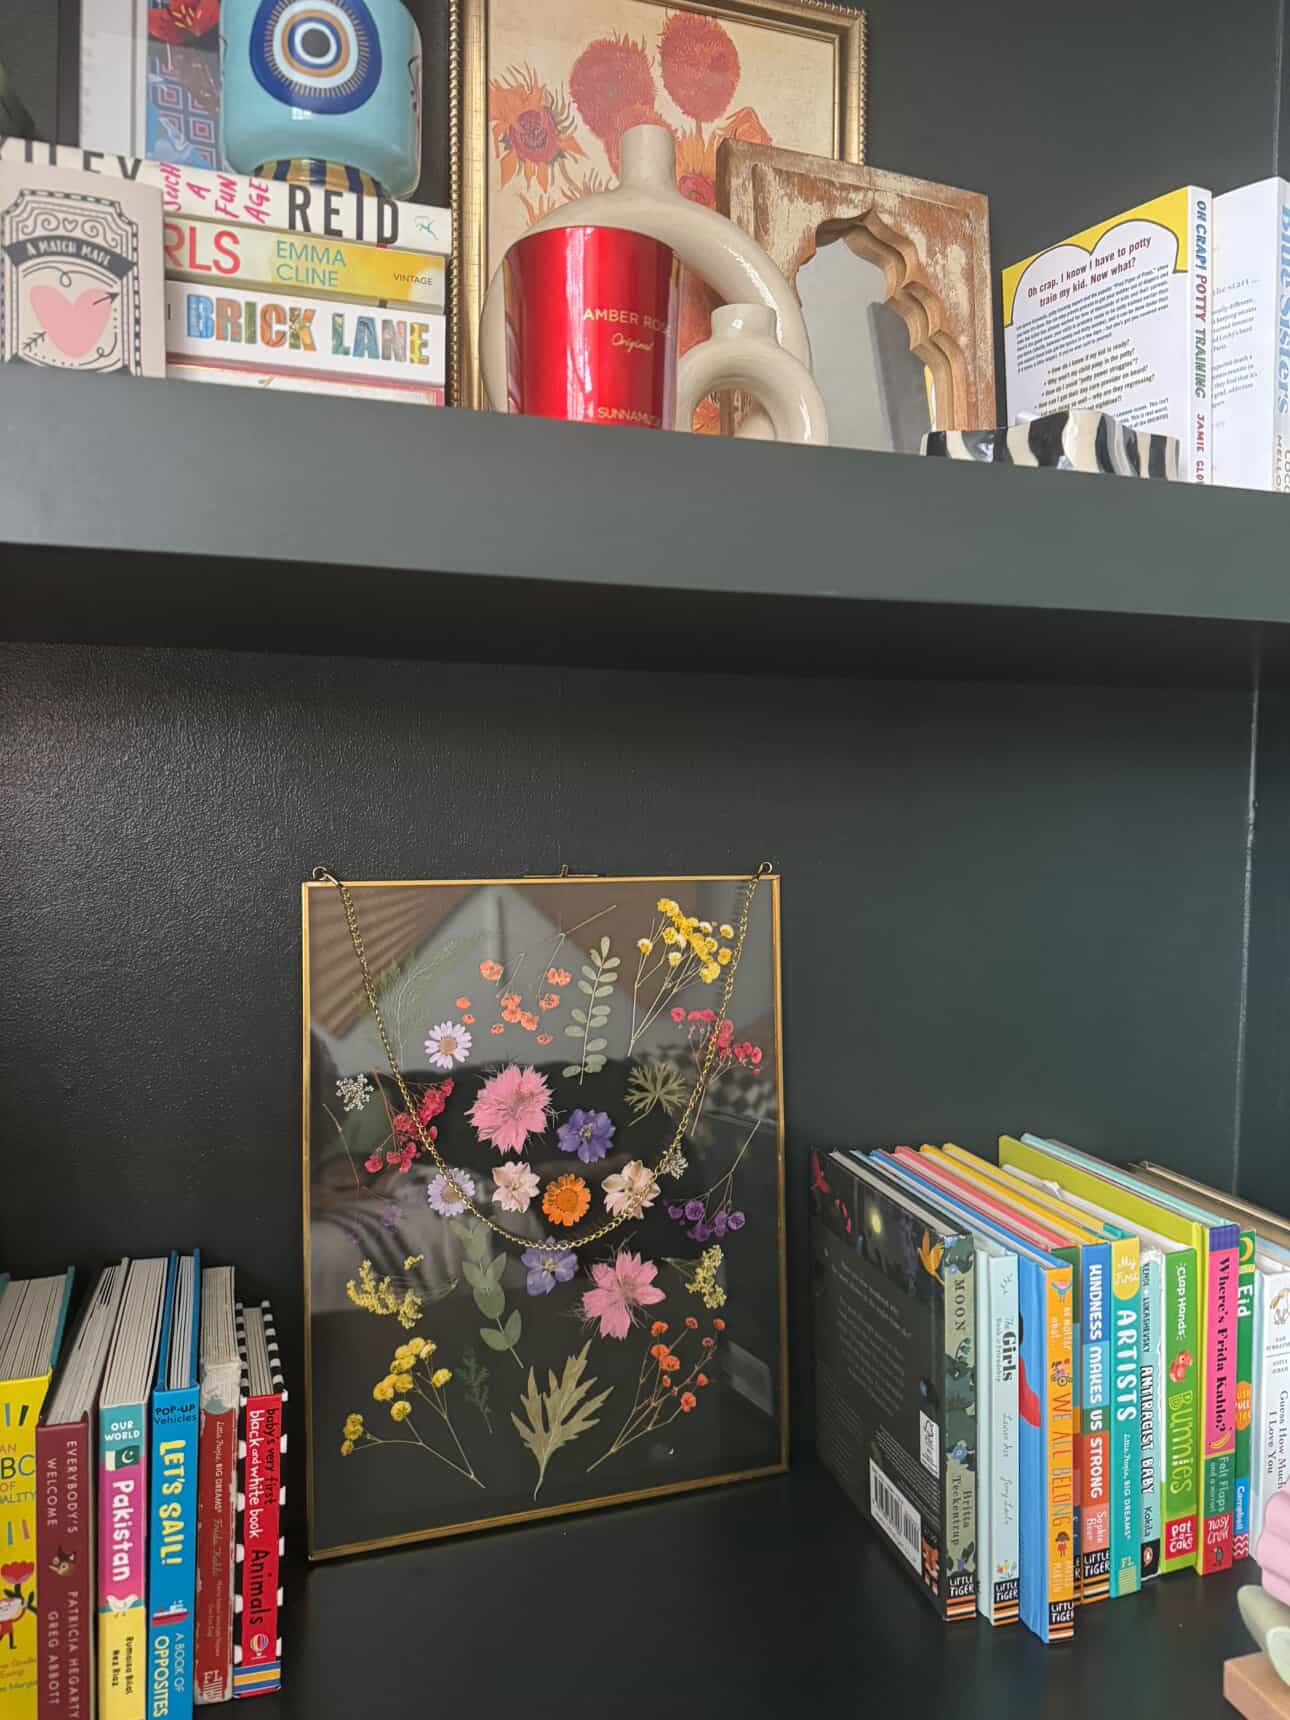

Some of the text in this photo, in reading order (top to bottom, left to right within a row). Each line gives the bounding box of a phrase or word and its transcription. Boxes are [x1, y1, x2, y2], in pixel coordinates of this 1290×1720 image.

[215, 173, 240, 219] FUN
[243, 176, 271, 224] AGE
[288, 184, 399, 245] REID
[1196, 200, 1207, 222] OH
[276, 240, 346, 266] EMMA
[1028, 287, 1037, 298] Oh
[1039, 279, 1058, 293] crap.
[1066, 266, 1087, 280] know
[1095, 252, 1115, 267] have
[1117, 246, 1126, 257] to
[1129, 236, 1152, 255] potty
[1195, 224, 1207, 270] CRAP!
[275, 263, 339, 288] CLINE
[393, 273, 433, 286] VINTAGE
[1039, 257, 1136, 307] train my kid. Now what?
[1195, 274, 1208, 322] POTTY
[186, 293, 430, 365] BRICK LANE
[583, 308, 639, 325] AMBER
[1195, 328, 1207, 399] TRAINING
[1196, 414, 1205, 452] JAMIE
[955, 1279, 967, 1331] MOON
[1176, 1267, 1186, 1296] Clap
[1237, 1285, 1253, 1317] Eid
[1002, 1331, 1017, 1382] Girls
[1116, 1310, 1137, 1421] ARTISTS
[1215, 1256, 1230, 1432] Where's Frida Kahlo?
[1089, 1264, 1103, 1499] KINDNESS MAKES US STRONG
[111, 1420, 134, 1431] OUR
[154, 1413, 197, 1425] Vehicles
[155, 1403, 195, 1417] POP-UP
[1279, 1390, 1288, 1424] Guess
[105, 1430, 140, 1441] WORLD
[264, 1408, 279, 1505] baby's very first
[1168, 1390, 1193, 1494] Bunnies
[1267, 1419, 1277, 1447] Love
[1278, 1427, 1288, 1454] How
[248, 1410, 265, 1538] black and white book
[1051, 1393, 1072, 1527] WE ALL BELONG
[1141, 1457, 1153, 1495] BABY
[1218, 1456, 1229, 1512] Felt Flaps
[1267, 1451, 1276, 1474] You
[47, 1457, 58, 1526] WELCOME
[67, 1440, 78, 1533] EVERYBODY'S
[159, 1439, 186, 1566] LET'S SAIL!
[962, 1490, 974, 1528] Britta
[112, 1480, 135, 1581] Pakistan
[249, 1549, 272, 1625] Animals
[48, 1611, 60, 1704] GREG ABBOTT
[68, 1591, 80, 1718] PATRICIA HEGARTY
[153, 1636, 170, 1718] OPPOSITES
[174, 1632, 184, 1693] A BOOK OF
